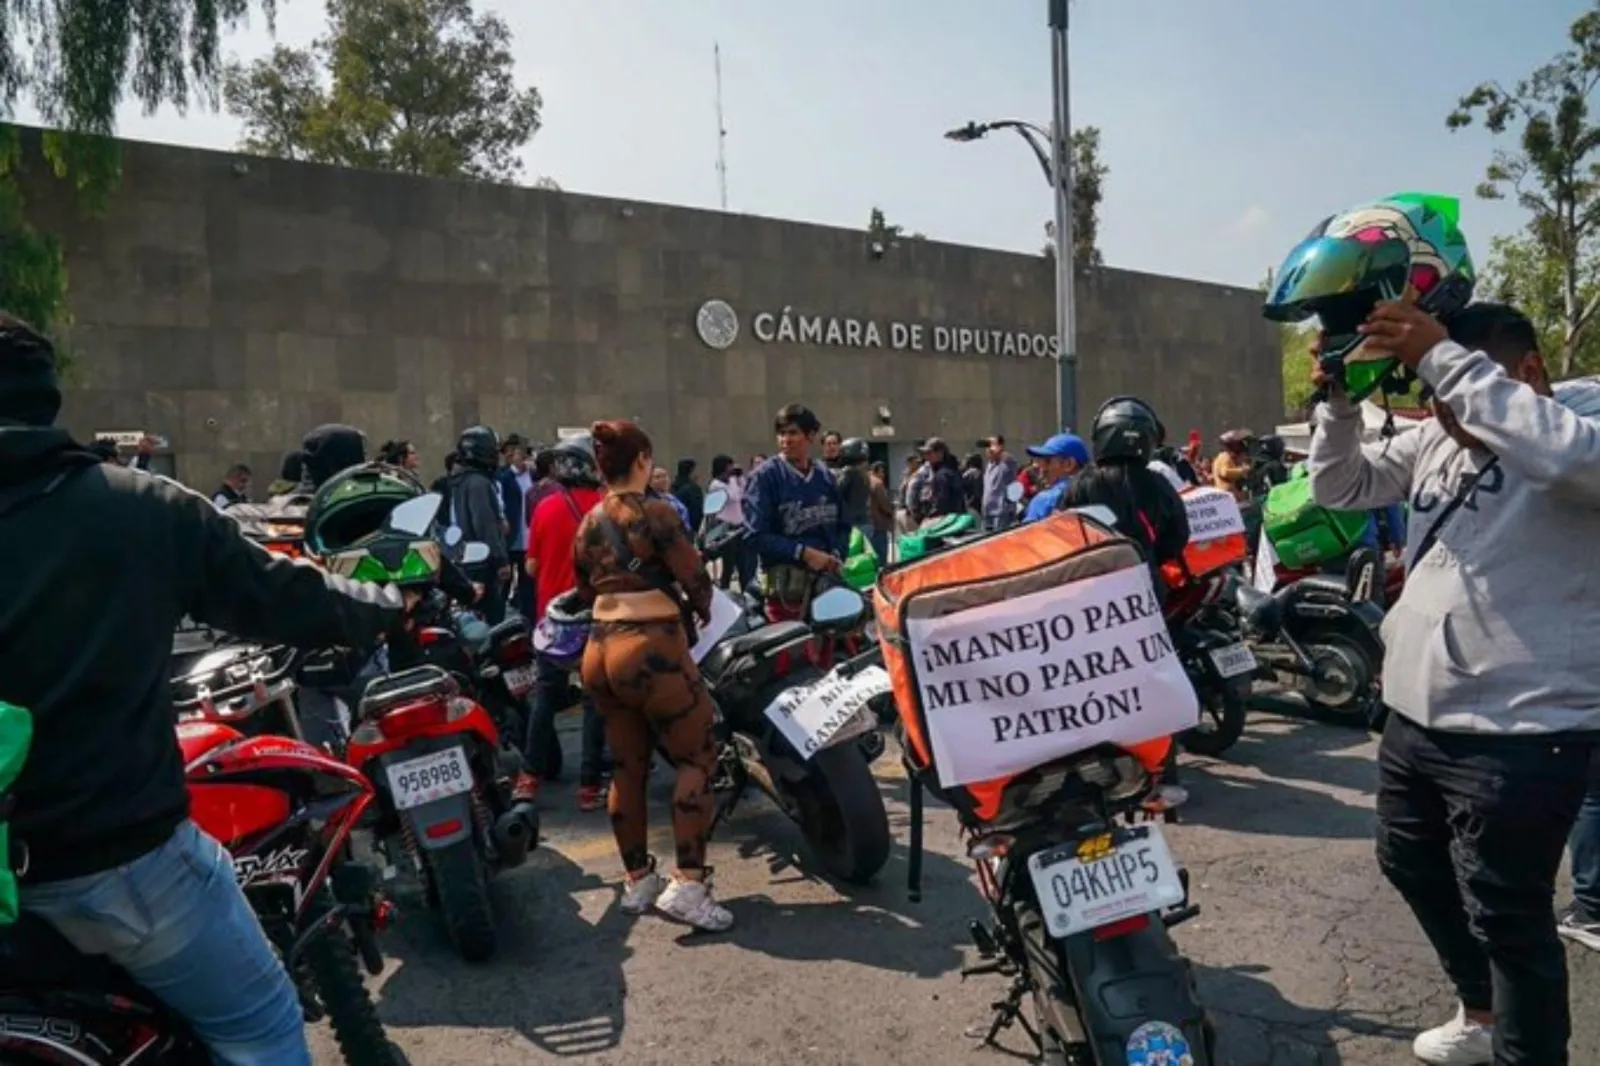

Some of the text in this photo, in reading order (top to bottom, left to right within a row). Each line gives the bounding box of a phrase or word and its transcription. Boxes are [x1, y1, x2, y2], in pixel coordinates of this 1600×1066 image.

[754, 306, 1060, 359] CÁMARA DE DIPUTADOS
[922, 590, 1160, 673] ¡MANEJO PARA
[925, 630, 1174, 711] MI NO PARA UN
[991, 687, 1143, 744] PATRÓN!
[1051, 847, 1159, 908] 04KHP5
